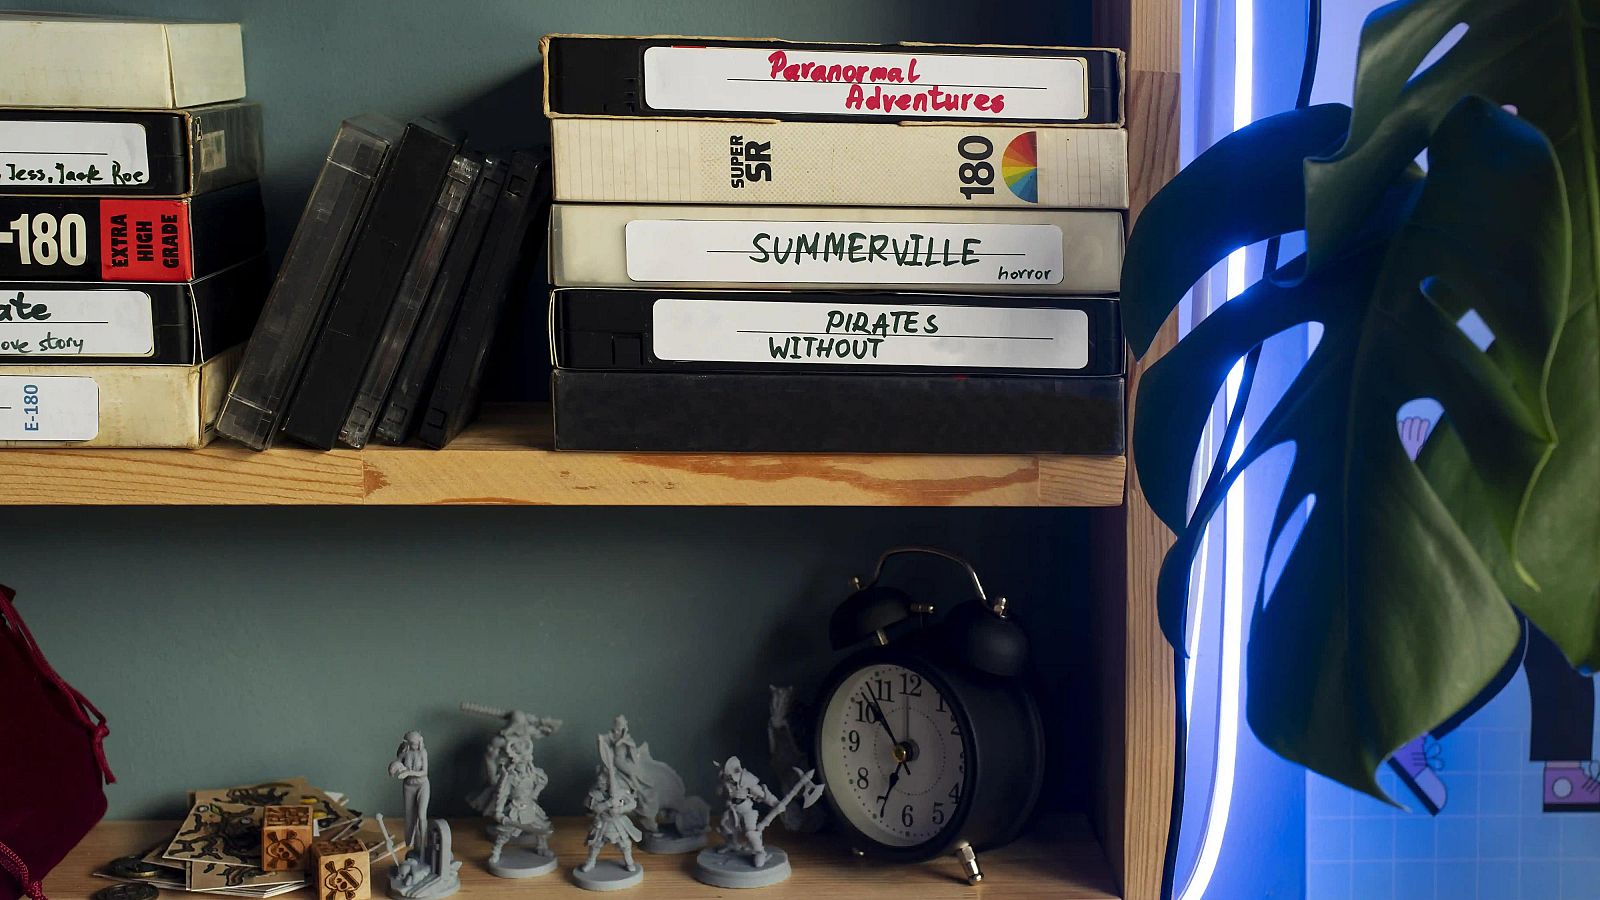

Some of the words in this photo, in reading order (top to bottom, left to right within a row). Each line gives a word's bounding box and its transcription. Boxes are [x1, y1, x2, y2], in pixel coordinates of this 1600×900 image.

[768, 50, 921, 83] Paranormal
[845, 84, 1005, 113] Adventures
[112, 160, 144, 185] Roe
[730, 135, 745, 189] SUPER
[745, 140, 772, 182] SR
[957, 135, 995, 200] 180
[110, 214, 129, 268] EXTRA
[136, 221, 154, 262] HIGH
[161, 214, 180, 269] GRADE
[749, 232, 982, 267] SUMMERVILLE
[998, 266, 1052, 281] horror
[826, 311, 939, 338] PIRATES
[39, 332, 84, 354] story
[768, 337, 884, 359] WITHOUT
[24, 384, 39, 431] E-180
[875, 680, 895, 703] 11
[900, 673, 922, 697] 12
[856, 701, 880, 725] 10
[848, 730, 860, 752] 9
[856, 767, 869, 789] 8
[948, 783, 961, 805] 4
[902, 805, 914, 828] 6
[932, 802, 945, 824] 5
